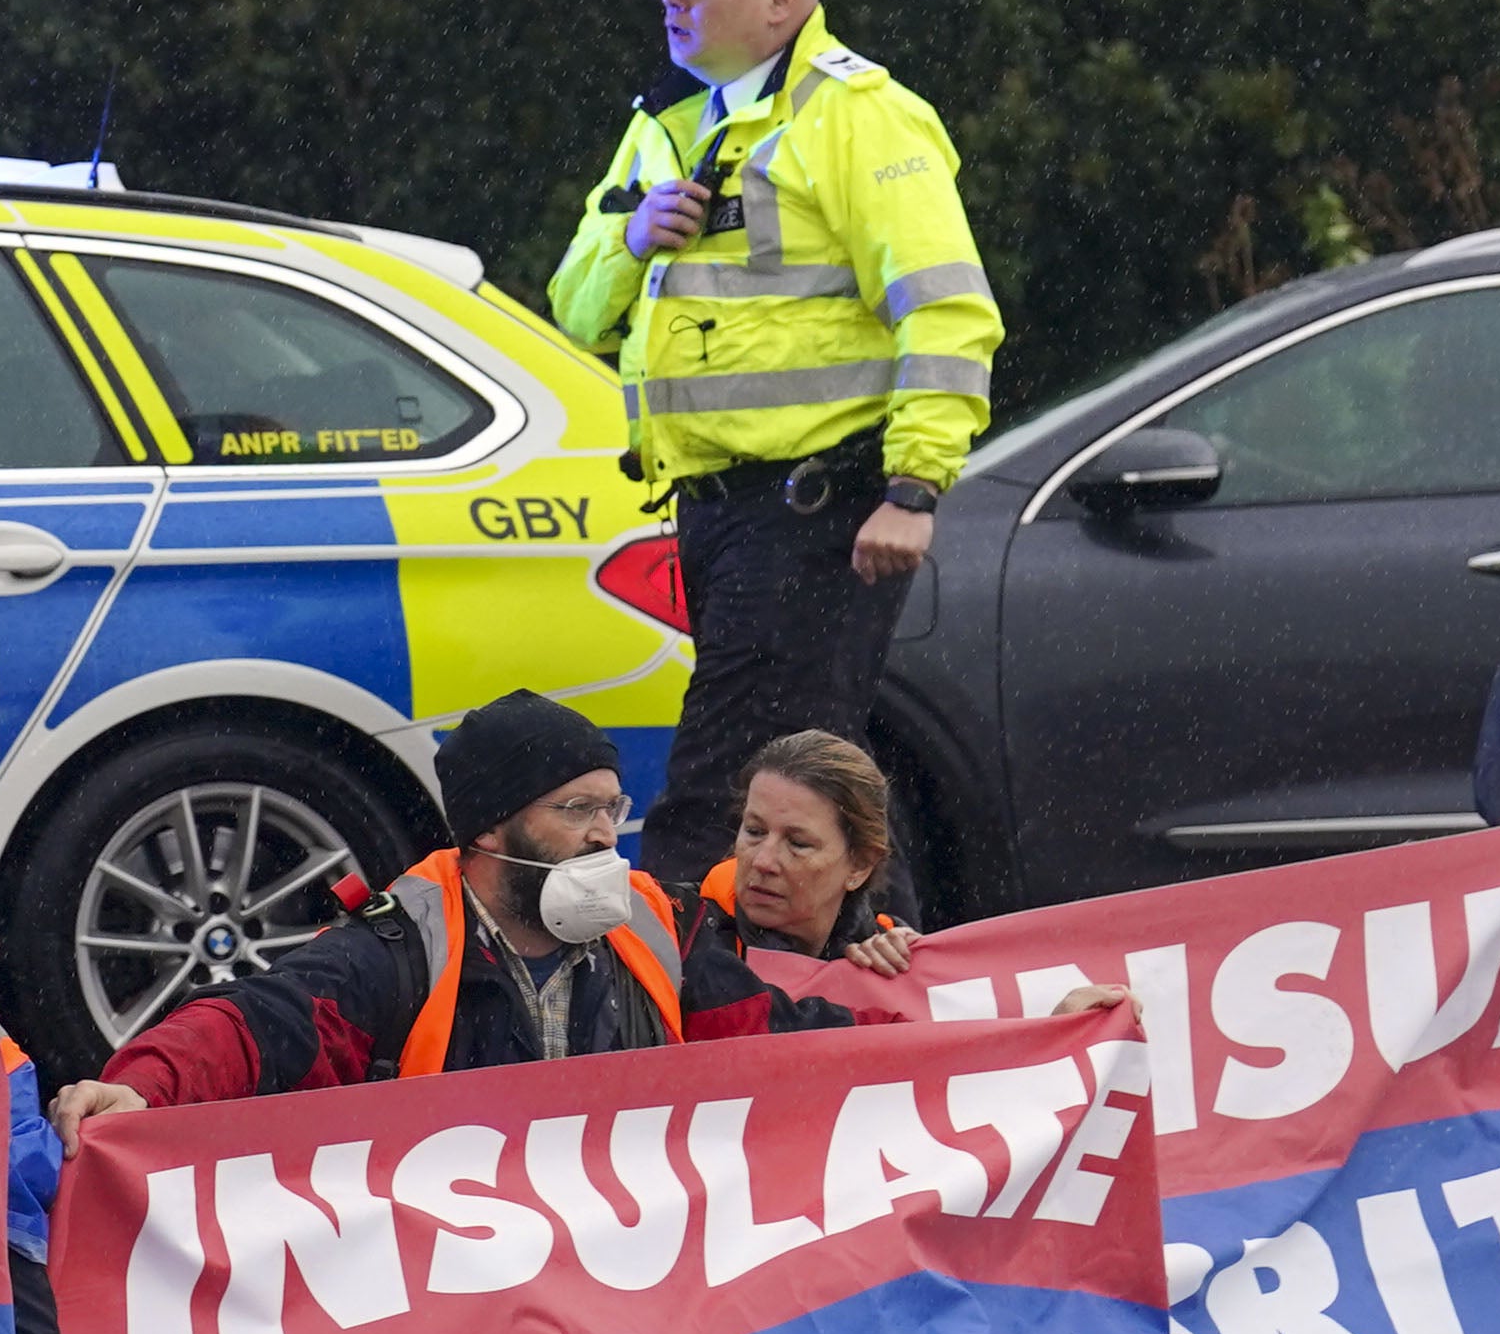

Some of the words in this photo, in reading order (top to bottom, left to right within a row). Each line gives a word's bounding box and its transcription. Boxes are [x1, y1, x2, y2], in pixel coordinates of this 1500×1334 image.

[872, 156, 930, 186] POLICE
[220, 430, 301, 457] ANPR
[469, 496, 590, 541] GBY
